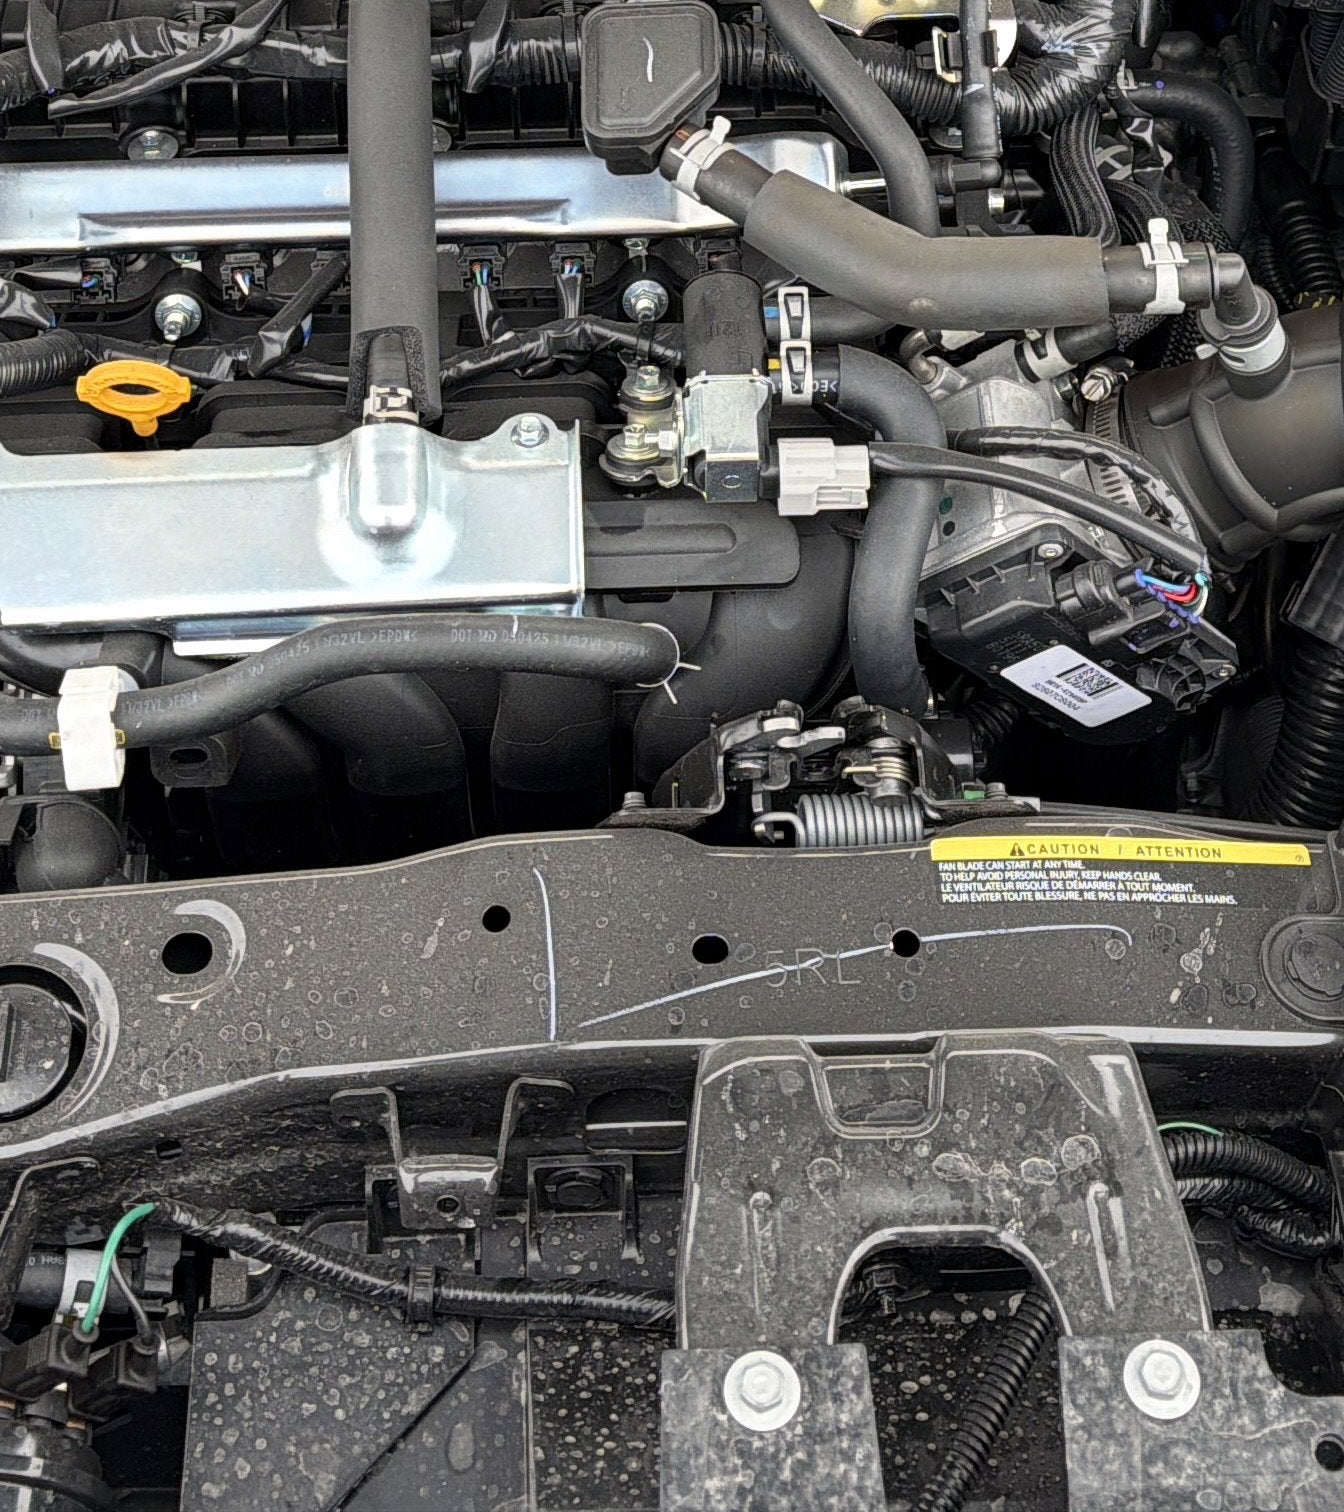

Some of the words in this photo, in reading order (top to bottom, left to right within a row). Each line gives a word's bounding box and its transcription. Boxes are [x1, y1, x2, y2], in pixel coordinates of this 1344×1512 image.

[1026, 843, 1100, 856] CAUTION
[1135, 845, 1223, 859] ATTENTION
[938, 861, 956, 872] FAN
[956, 861, 985, 871] BLADE
[985, 861, 1005, 871] CAN
[1005, 860, 1032, 870] START
[1032, 860, 1043, 870] AT
[1044, 860, 1063, 870] ANY
[940, 872, 954, 882] TO
[954, 872, 976, 882] HELP
[976, 871, 1004, 881] AVOID
[1004, 871, 1049, 881] PERSONAL
[1049, 871, 1081, 882] INJURY,
[1081, 871, 1102, 881] KEEP
[1102, 871, 1133, 882] HANDS
[941, 883, 953, 893] LE
[953, 881, 1016, 893] VENTILATEUR
[1015, 881, 1050, 892] RISQUE
[1051, 881, 1064, 891] DE
[1065, 879, 1116, 892] DÉMARRER
[1125, 881, 1151, 892] TOUT
[1151, 882, 1197, 894] MOMENT.
[942, 893, 970, 904] POUR
[970, 891, 1003, 903] ÉVITER
[1003, 891, 1035, 902] TOUTE
[1035, 891, 1083, 903] BLESSURE,
[1083, 891, 1096, 901] NE
[1097, 891, 1116, 902] PAS
[1116, 892, 1130, 902] EN
[1130, 893, 1187, 904] APPROCHER
[1187, 894, 1204, 904] LES
[1204, 894, 1239, 905] MAINS.
